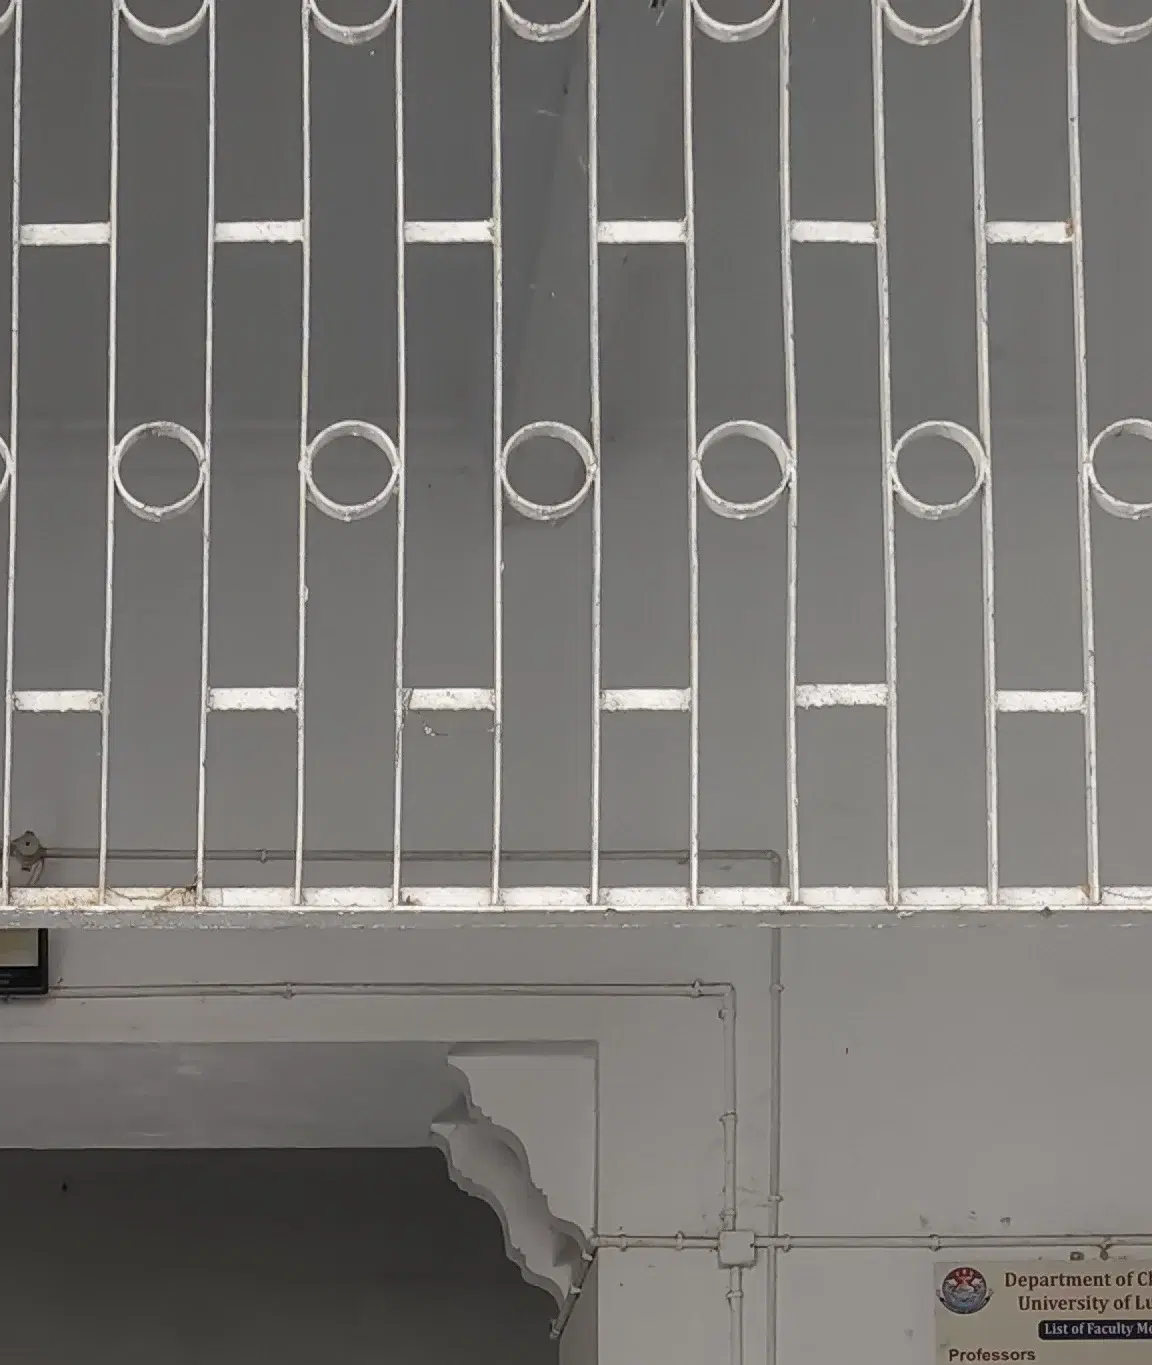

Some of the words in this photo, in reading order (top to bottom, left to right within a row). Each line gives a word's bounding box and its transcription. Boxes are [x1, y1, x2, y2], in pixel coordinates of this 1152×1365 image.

[1004, 1271, 1112, 1290] Department
[1115, 1271, 1134, 1286] of
[1018, 1295, 1109, 1314] University
[1113, 1294, 1132, 1310] of
[1044, 1321, 1068, 1335] List
[1071, 1321, 1084, 1335] of
[1086, 1321, 1133, 1337] Faculty
[948, 1347, 1035, 1361] Professors
